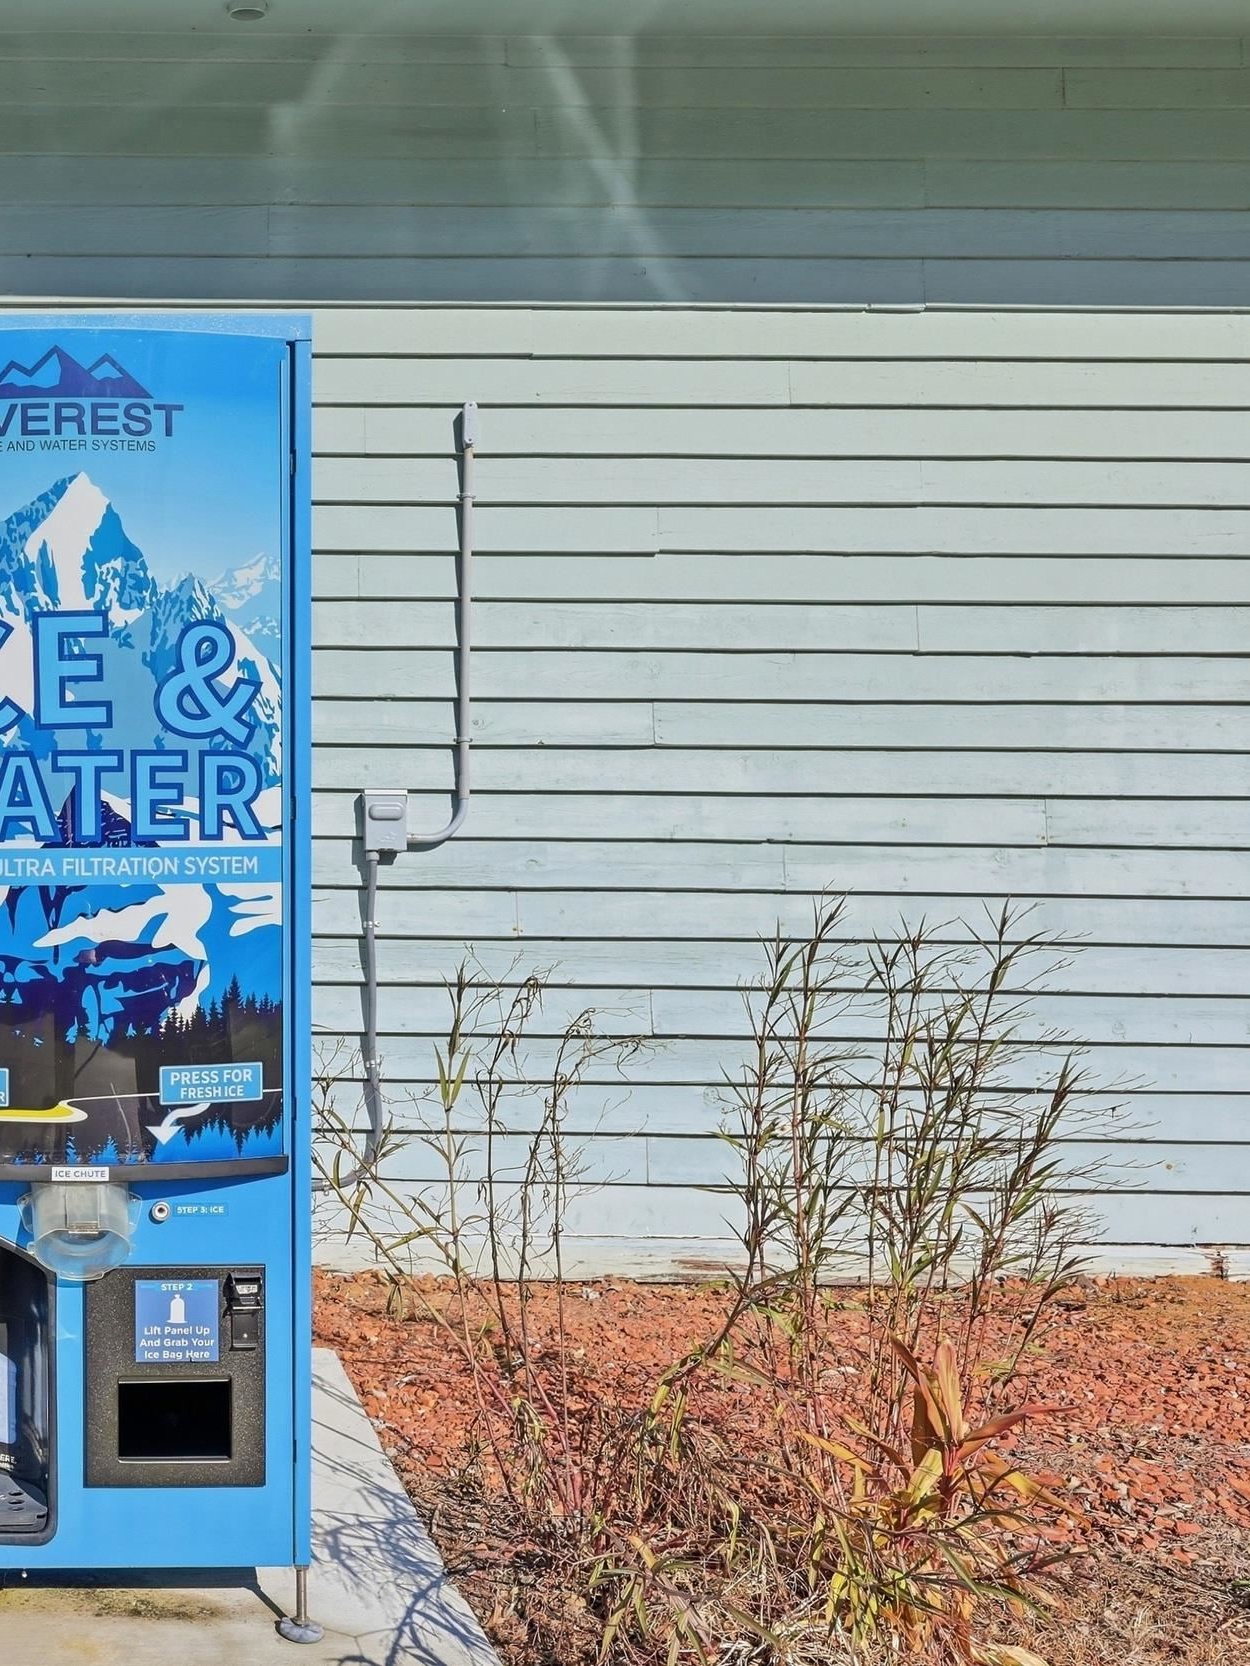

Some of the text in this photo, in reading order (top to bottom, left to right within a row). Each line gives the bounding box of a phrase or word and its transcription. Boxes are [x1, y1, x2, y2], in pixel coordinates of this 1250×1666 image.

[7, 440, 35, 452] AND
[39, 440, 86, 451] WATER
[92, 440, 156, 452] SYSTEMS
[154, 619, 263, 749] &
[63, 857, 178, 876] FILTRATION
[184, 856, 258, 875] SYSTEM
[170, 1069, 252, 1086] PRESS FOR
[180, 1085, 244, 1099] FRESH ICE
[144, 1326, 210, 1336] Lift Panel Up
[140, 1339, 160, 1347] And
[192, 1338, 214, 1346] Your
[163, 1351, 183, 1360] Bag
[186, 1350, 210, 1358] Here
